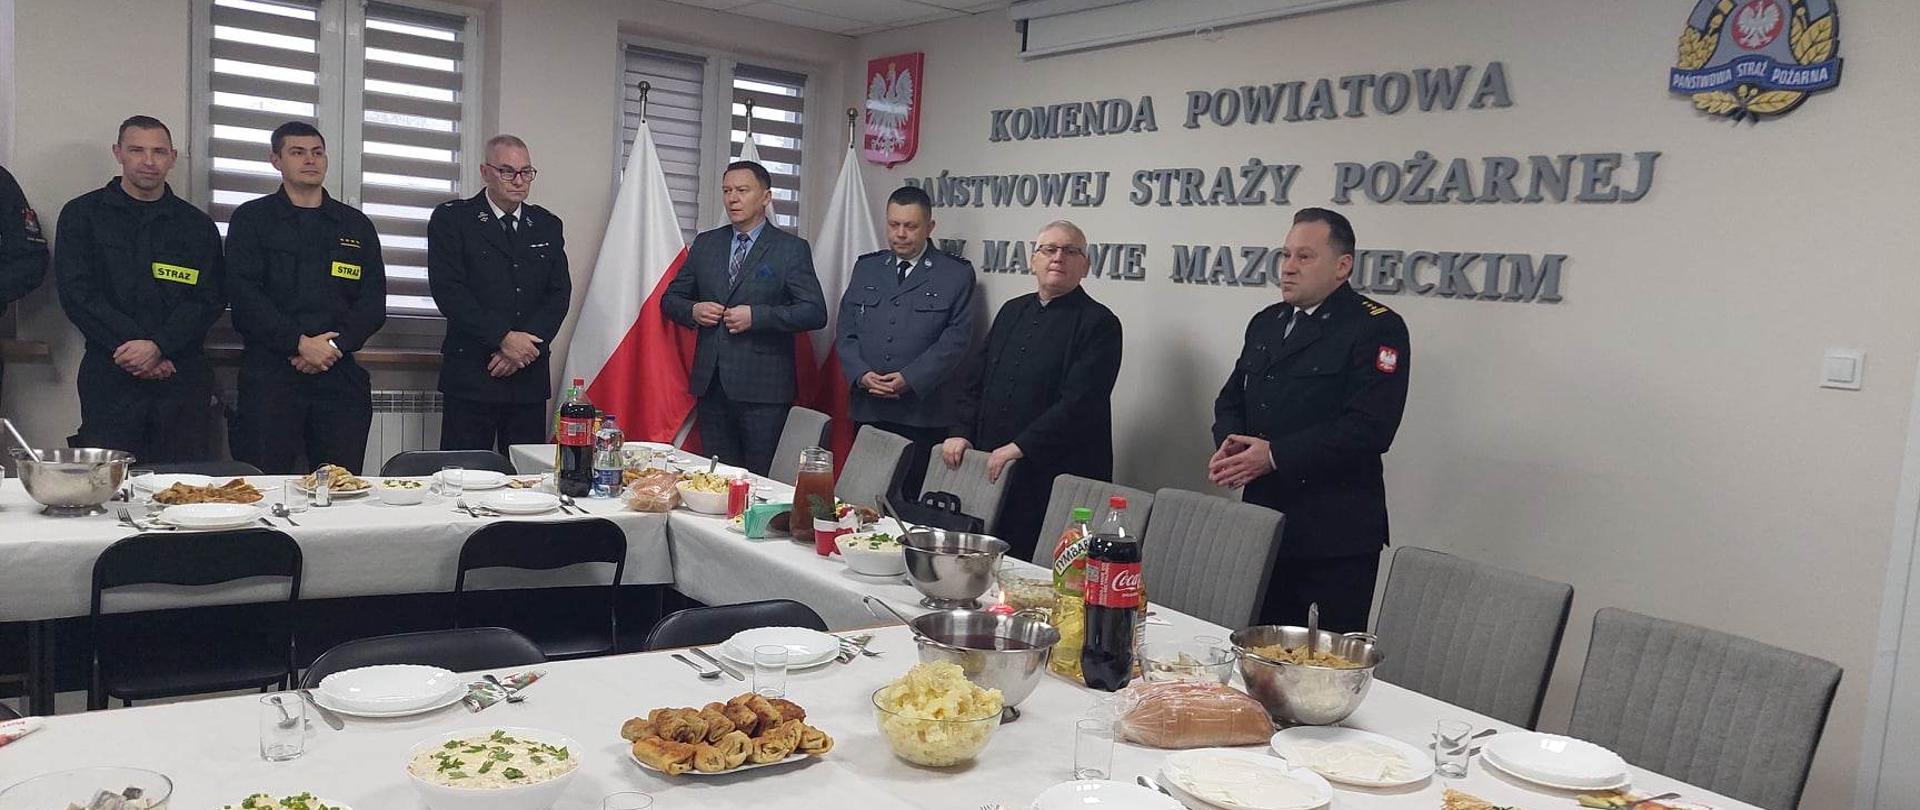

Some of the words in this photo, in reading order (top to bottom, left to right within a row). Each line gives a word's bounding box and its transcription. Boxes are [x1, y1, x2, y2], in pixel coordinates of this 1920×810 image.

[988, 95, 1158, 142] KOMENDA
[1182, 60, 1512, 129] POWIATOWA
[1771, 68, 1828, 85] POŻARNA
[1129, 158, 1301, 206] STRAŻY
[1330, 150, 1662, 205] POŻARNEJ
